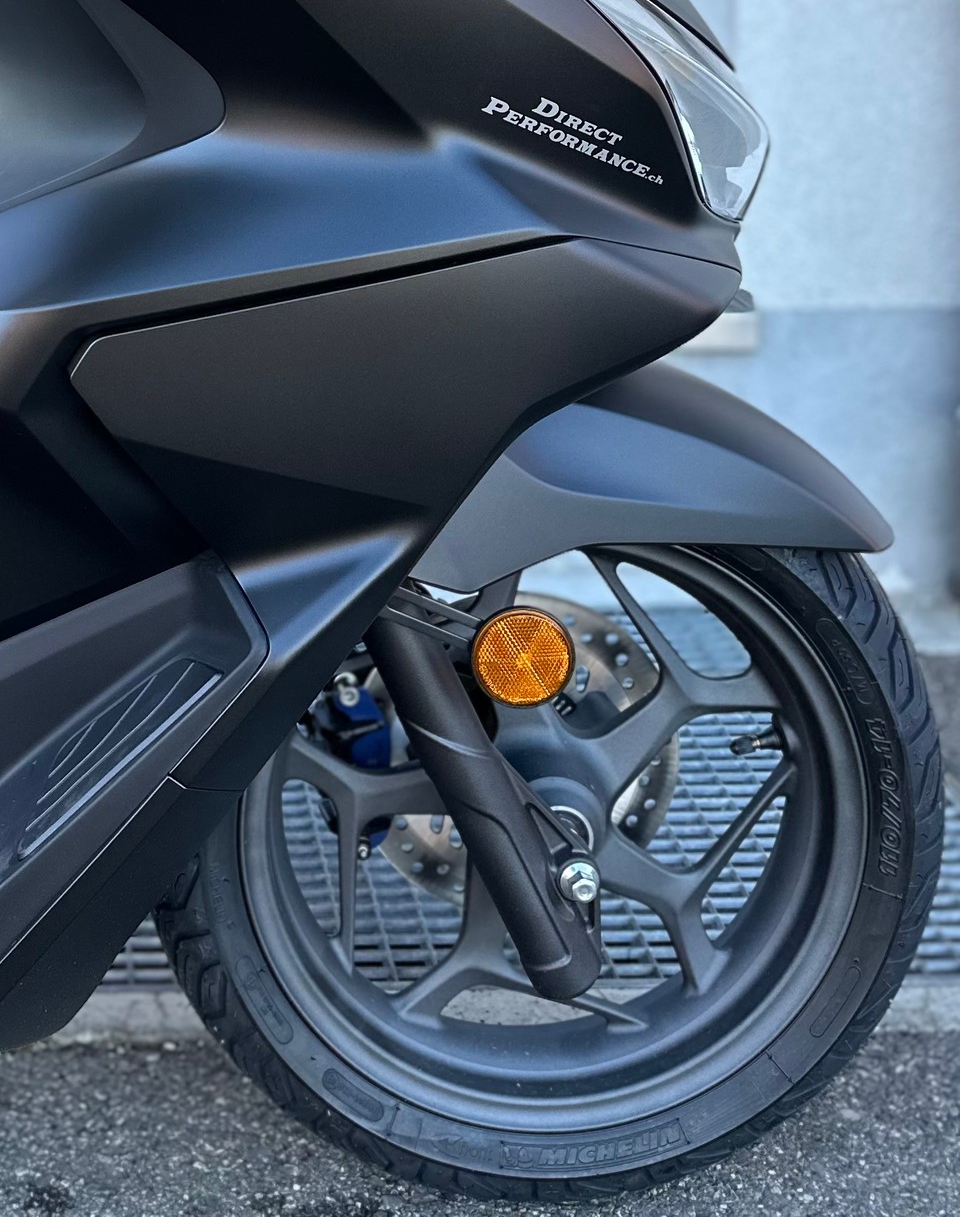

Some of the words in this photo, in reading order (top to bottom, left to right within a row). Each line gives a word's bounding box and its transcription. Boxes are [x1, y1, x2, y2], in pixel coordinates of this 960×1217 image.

[481, 96, 664, 185] PERFORMANCE.ch
[531, 96, 623, 146] DIRECT
[538, 1122, 683, 1166] MICHELIN
